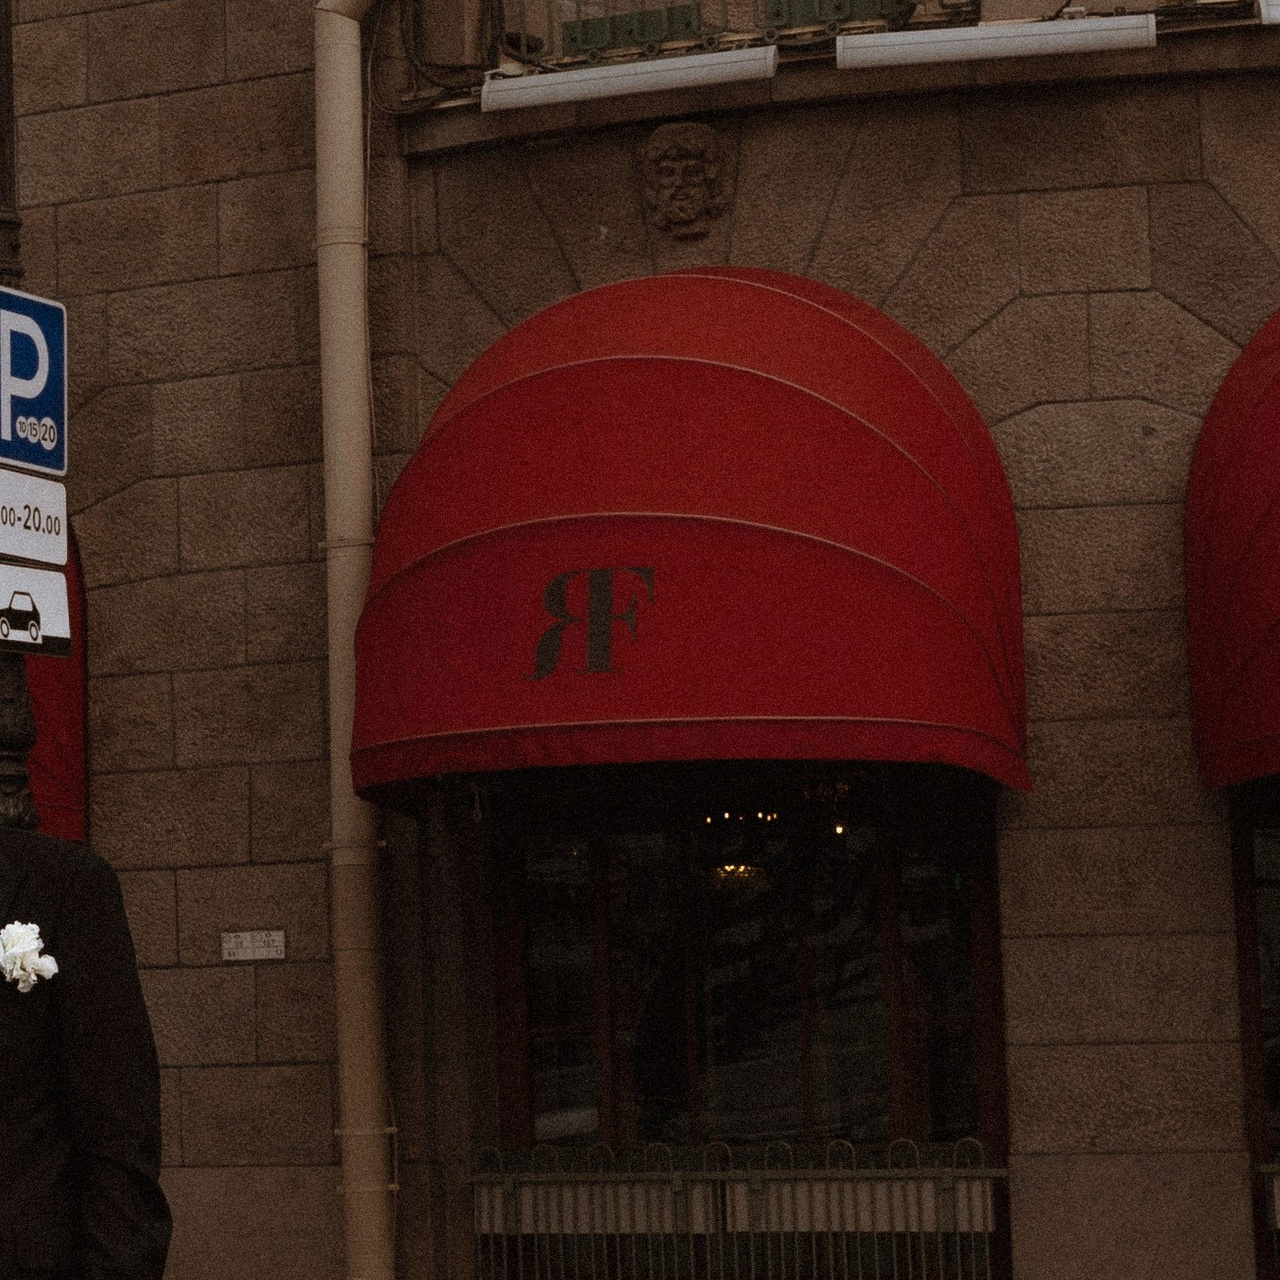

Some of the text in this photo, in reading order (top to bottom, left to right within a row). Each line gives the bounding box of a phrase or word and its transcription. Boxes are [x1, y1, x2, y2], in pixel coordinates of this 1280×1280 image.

[0, 309, 50, 441] P
[19, 420, 56, 443] 10 15 20
